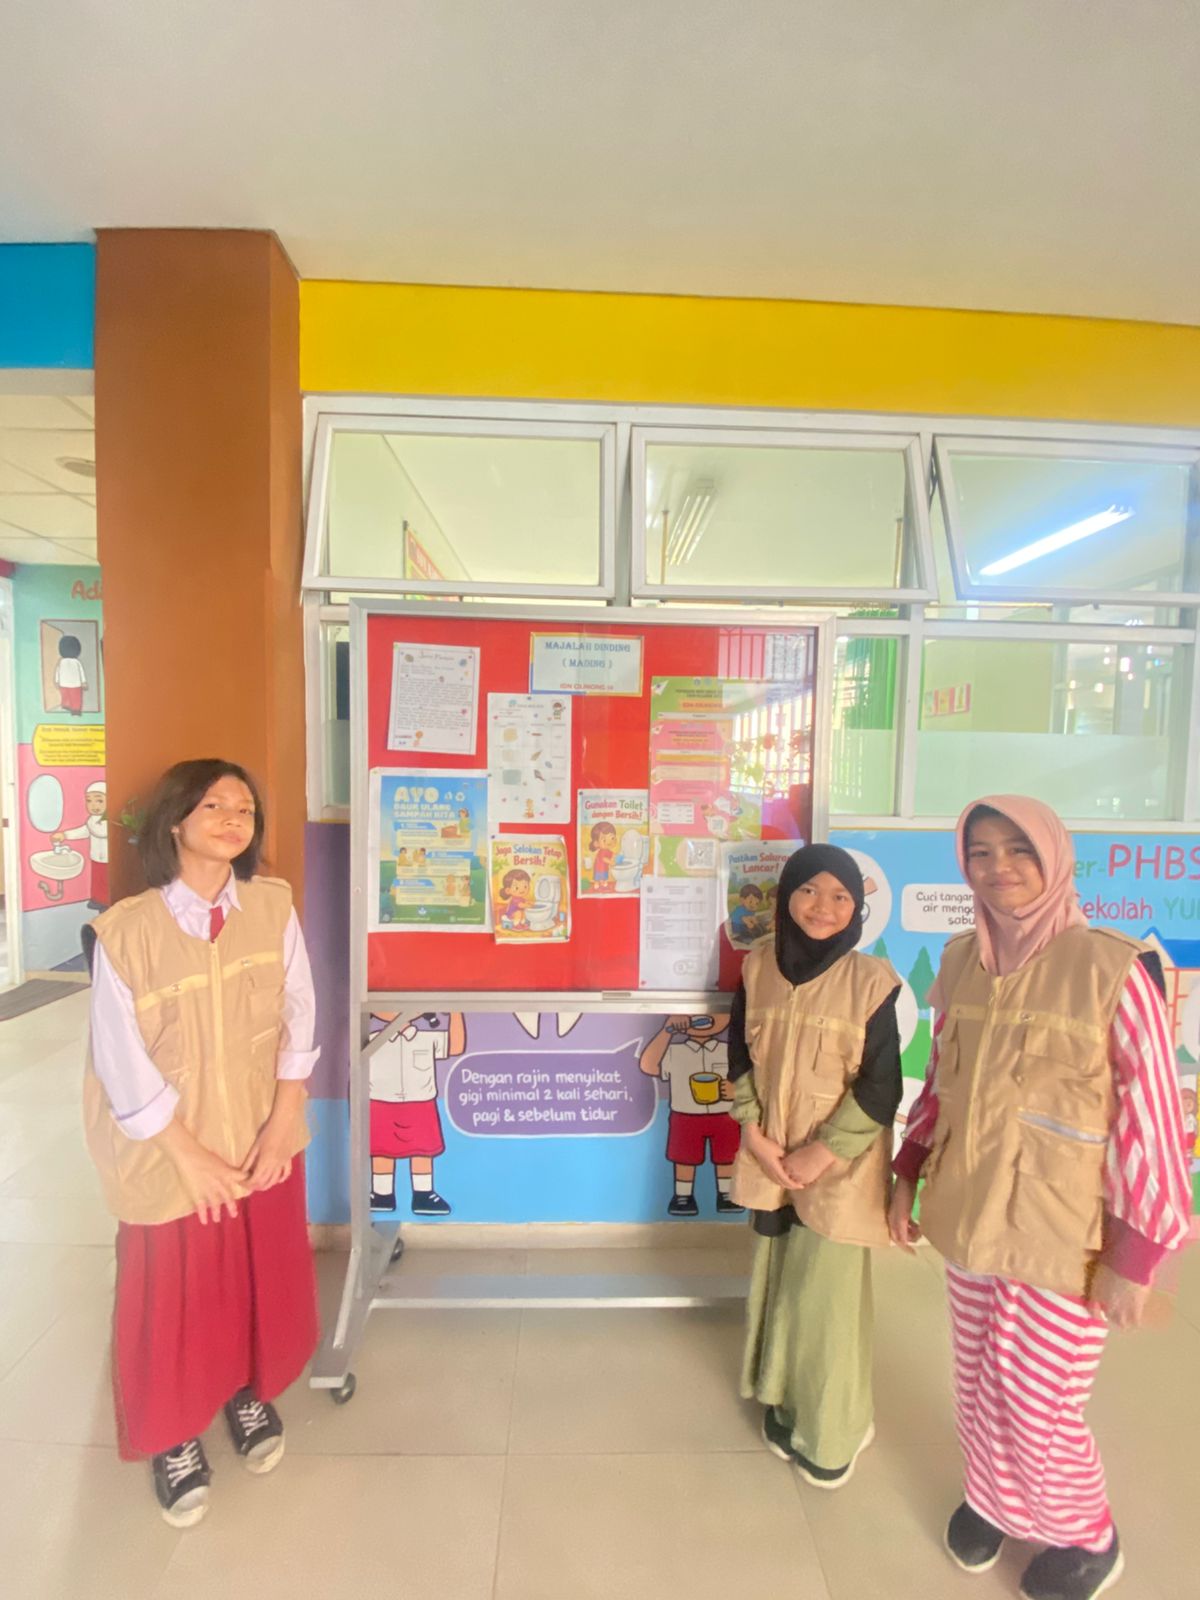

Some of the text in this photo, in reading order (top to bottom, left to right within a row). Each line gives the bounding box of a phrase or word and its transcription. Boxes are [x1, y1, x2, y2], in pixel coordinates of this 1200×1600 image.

[544, 641, 631, 653] MAJALAH DINDING
[569, 659, 606, 668] MADING
[394, 786, 439, 803] AYO
[584, 799, 643, 810] Gunakan Toilet
[496, 844, 562, 859] Jaga Selokan Tetap
[513, 855, 546, 866] Bersih!
[728, 853, 758, 864] Pastikan
[742, 863, 779, 874] Lancar!
[916, 891, 938, 901] Cuci
[922, 903, 938, 913] air
[1076, 894, 1153, 920] ekolah
[461, 1068, 622, 1088] Dengan rajin menyikat
[458, 1088, 483, 1107] gigi
[486, 1088, 540, 1101] minimal
[543, 1089, 553, 1101] 2
[557, 1087, 580, 1101] kali
[472, 1107, 618, 1127] pagi & sebelum tidur
